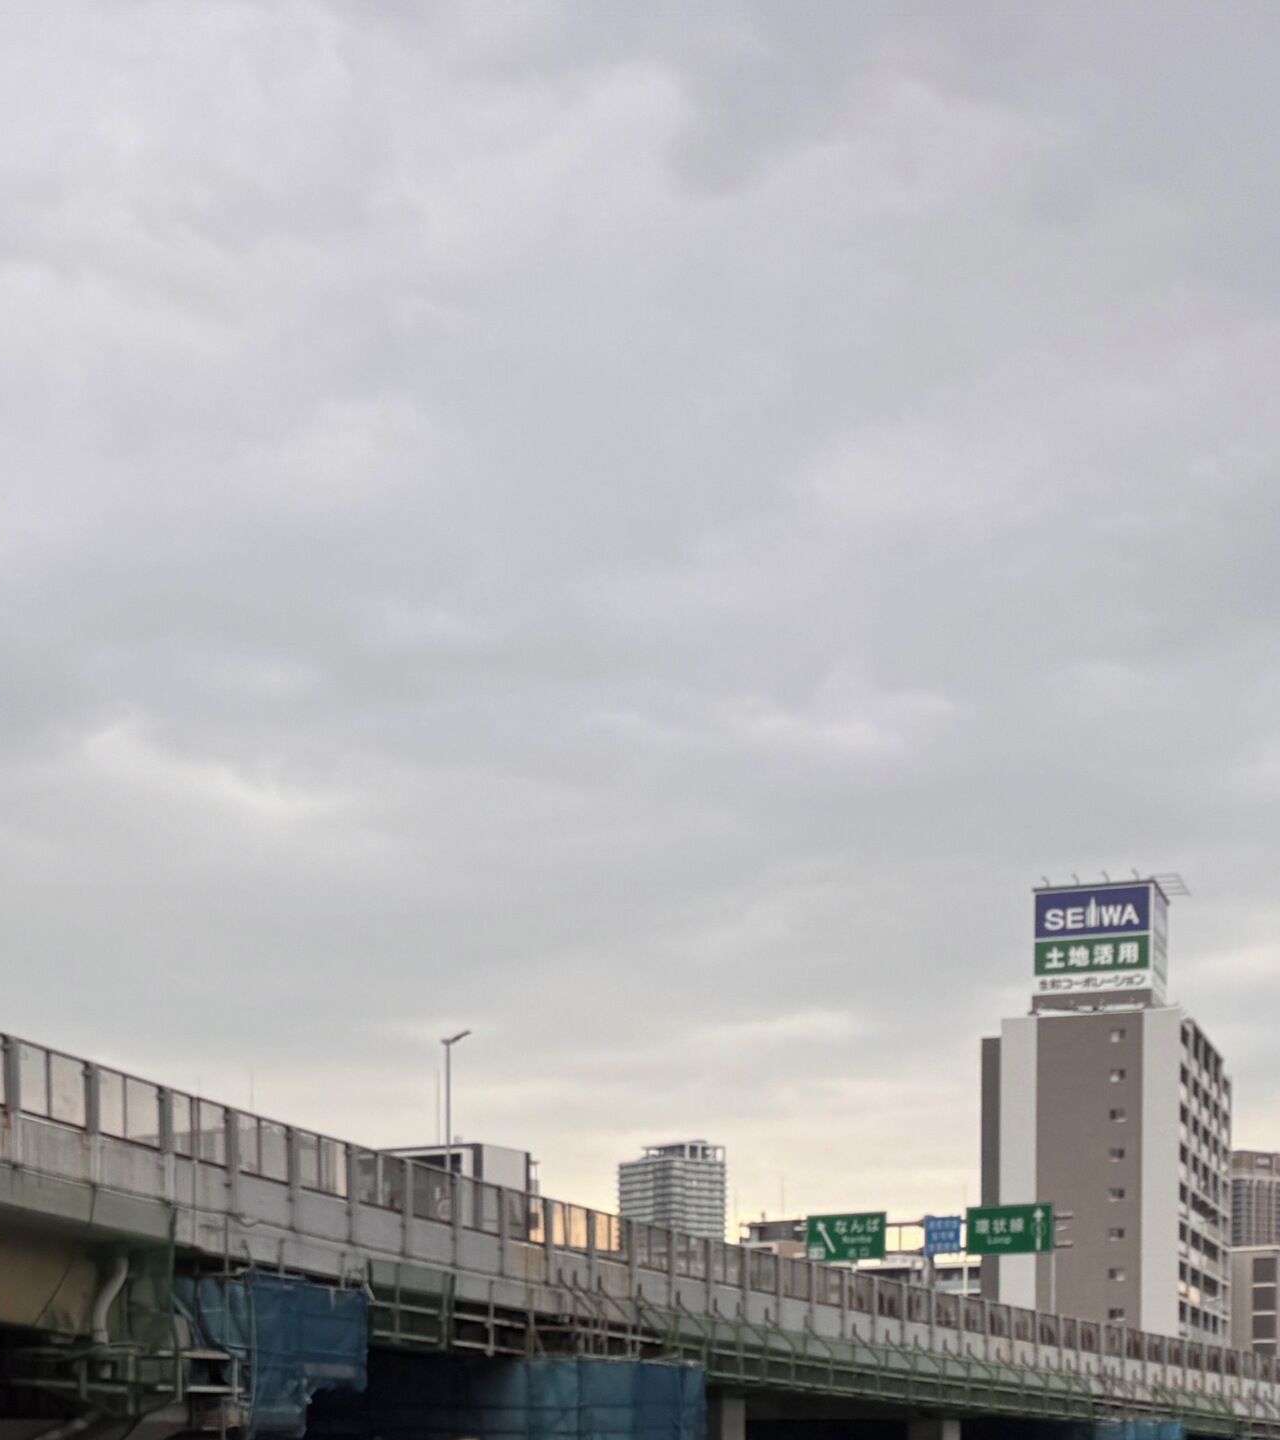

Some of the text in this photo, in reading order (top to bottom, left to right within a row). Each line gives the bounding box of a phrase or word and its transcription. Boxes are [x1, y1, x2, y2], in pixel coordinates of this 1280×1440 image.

[1044, 896, 1140, 930] SEIWA
[1044, 941, 1139, 969] 土地活用
[835, 1218, 880, 1234] なんば
